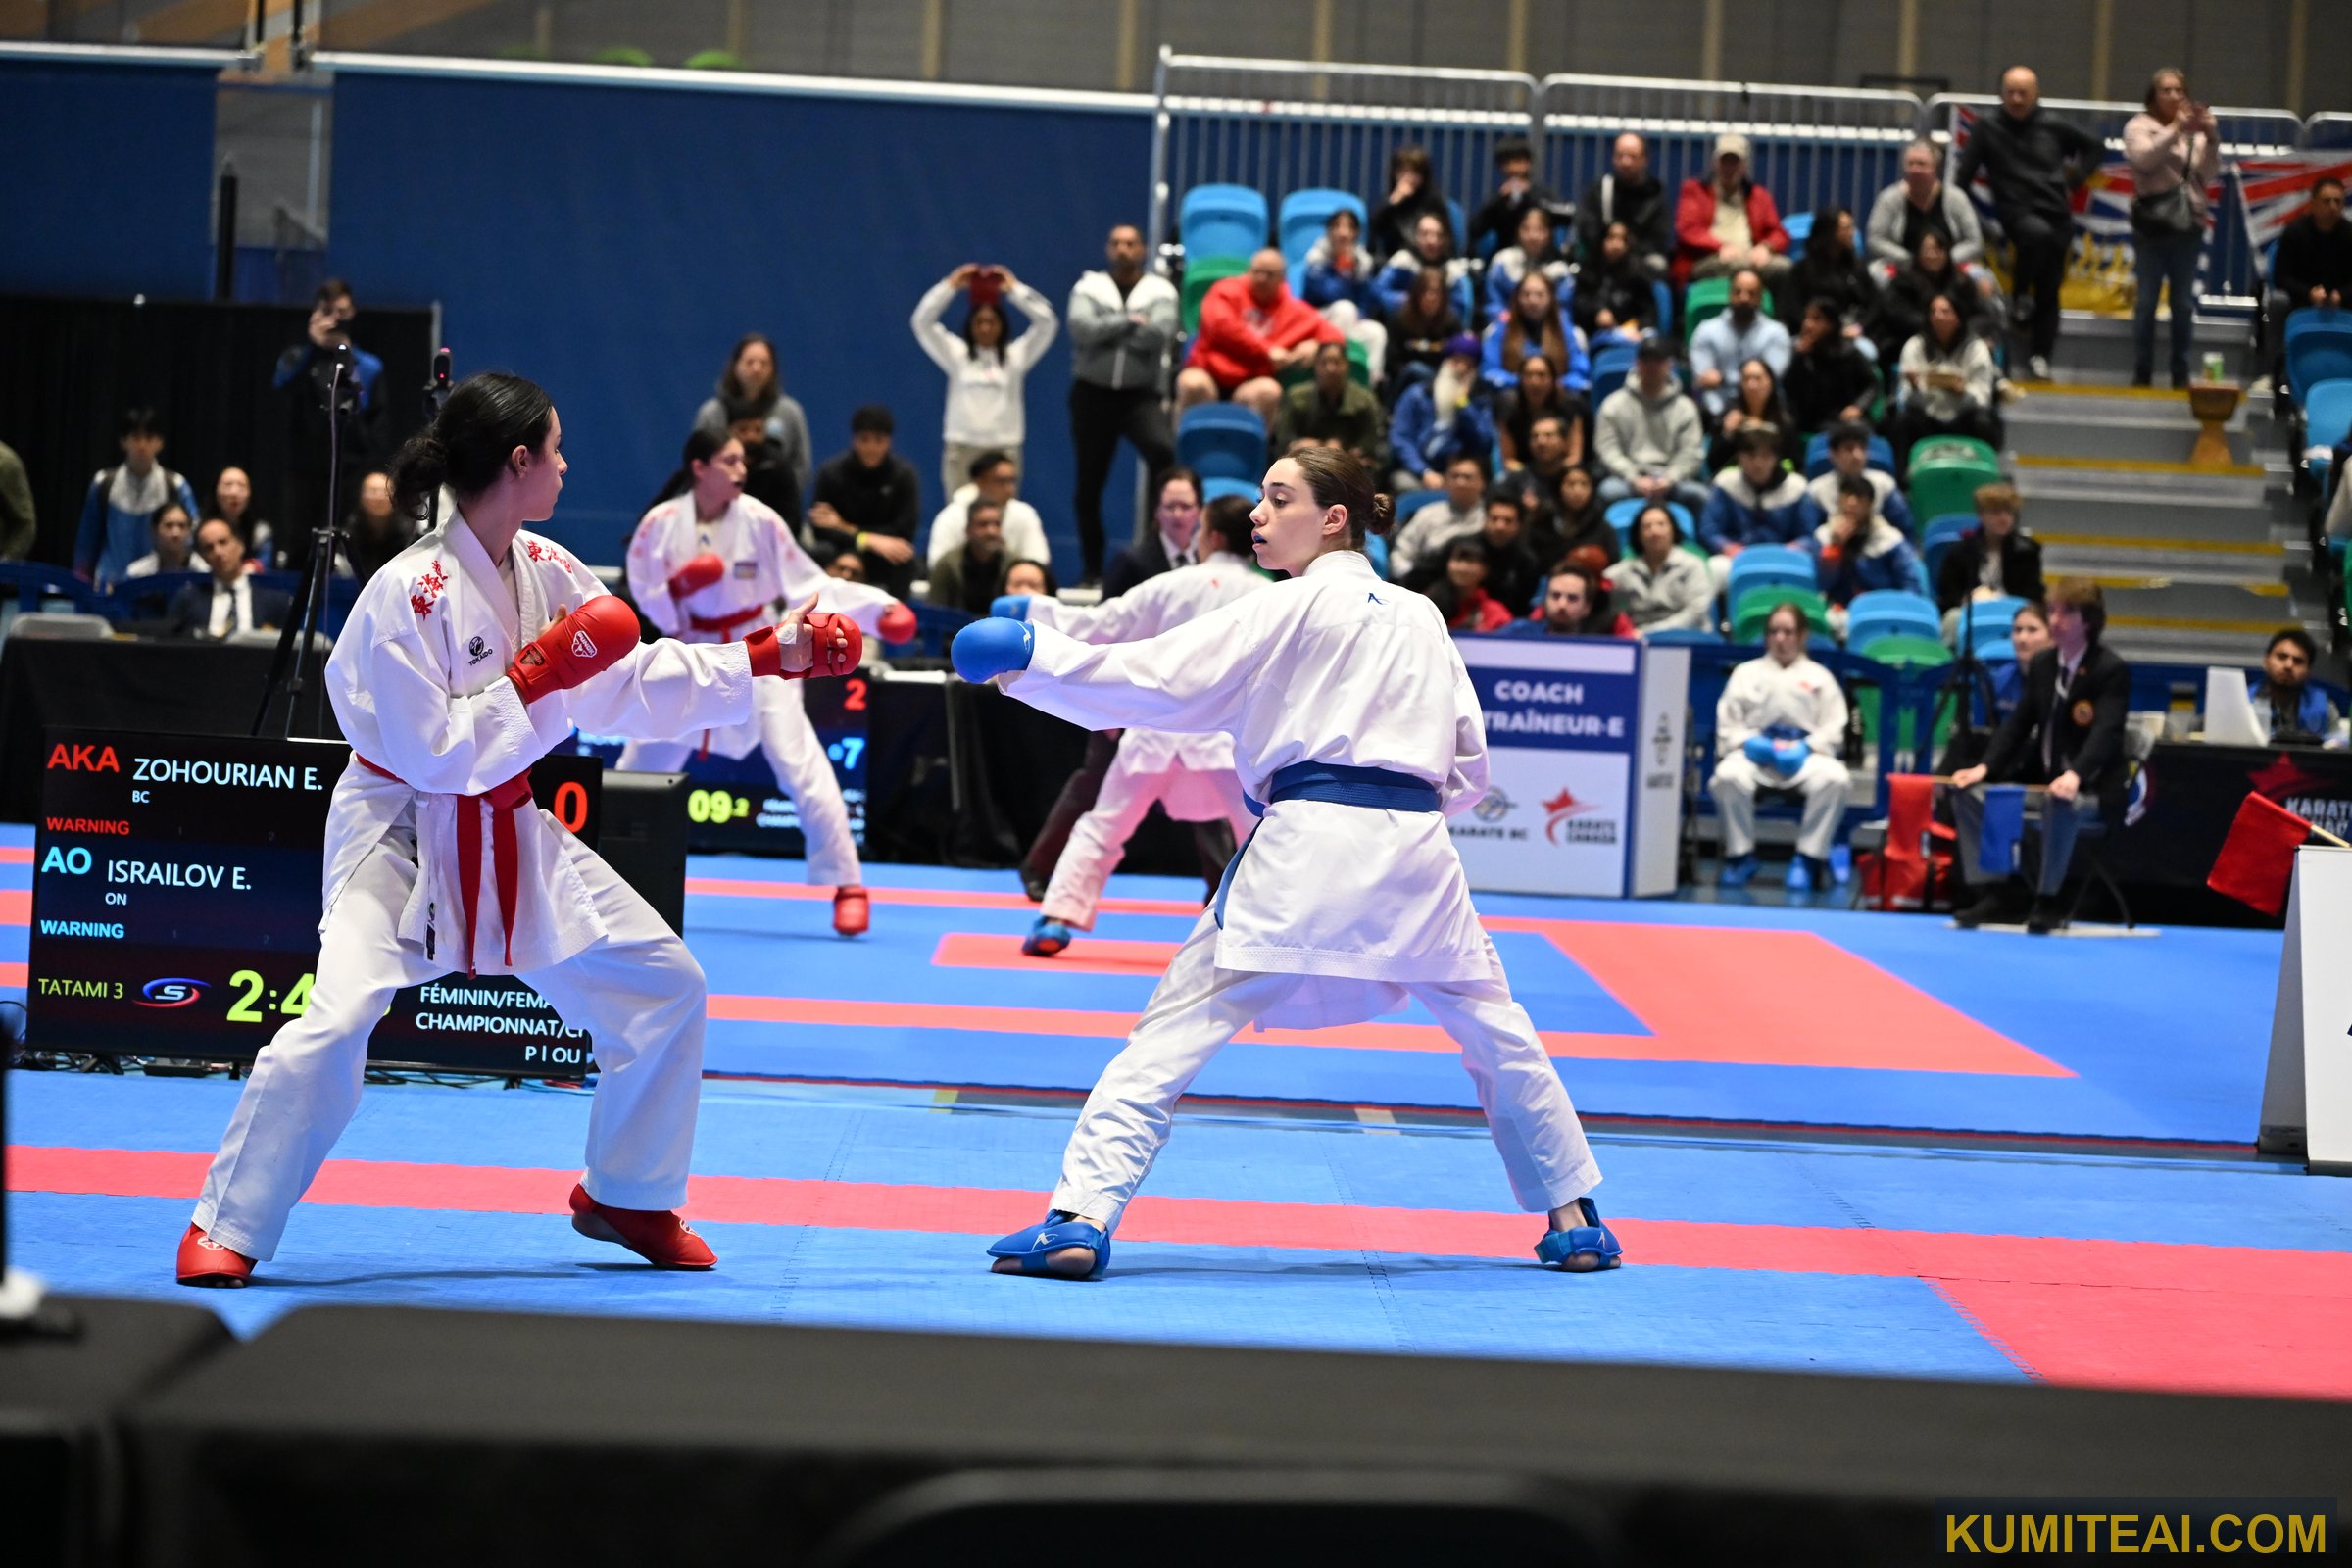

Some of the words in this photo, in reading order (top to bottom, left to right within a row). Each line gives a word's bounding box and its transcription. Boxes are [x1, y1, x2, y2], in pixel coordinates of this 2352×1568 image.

[468, 649, 493, 666] TOKAIDO
[844, 679, 866, 710] 2
[1494, 680, 1584, 705] COACH
[47, 744, 120, 772] AKA
[133, 759, 294, 789] ZOHOURIAN
[304, 767, 323, 790] E.
[132, 790, 150, 803] BC
[554, 782, 588, 835] 0
[2286, 797, 2352, 823] KARAT
[47, 817, 129, 835] WARNING
[41, 846, 92, 874] AO
[108, 860, 224, 888] ISRAILOV
[232, 867, 252, 890] E.
[105, 892, 127, 906] ON
[40, 919, 124, 939] WARNING
[38, 978, 107, 998] TATAMI
[113, 982, 123, 999] 3
[525, 1046, 537, 1061] P
[552, 1047, 580, 1063] OU
